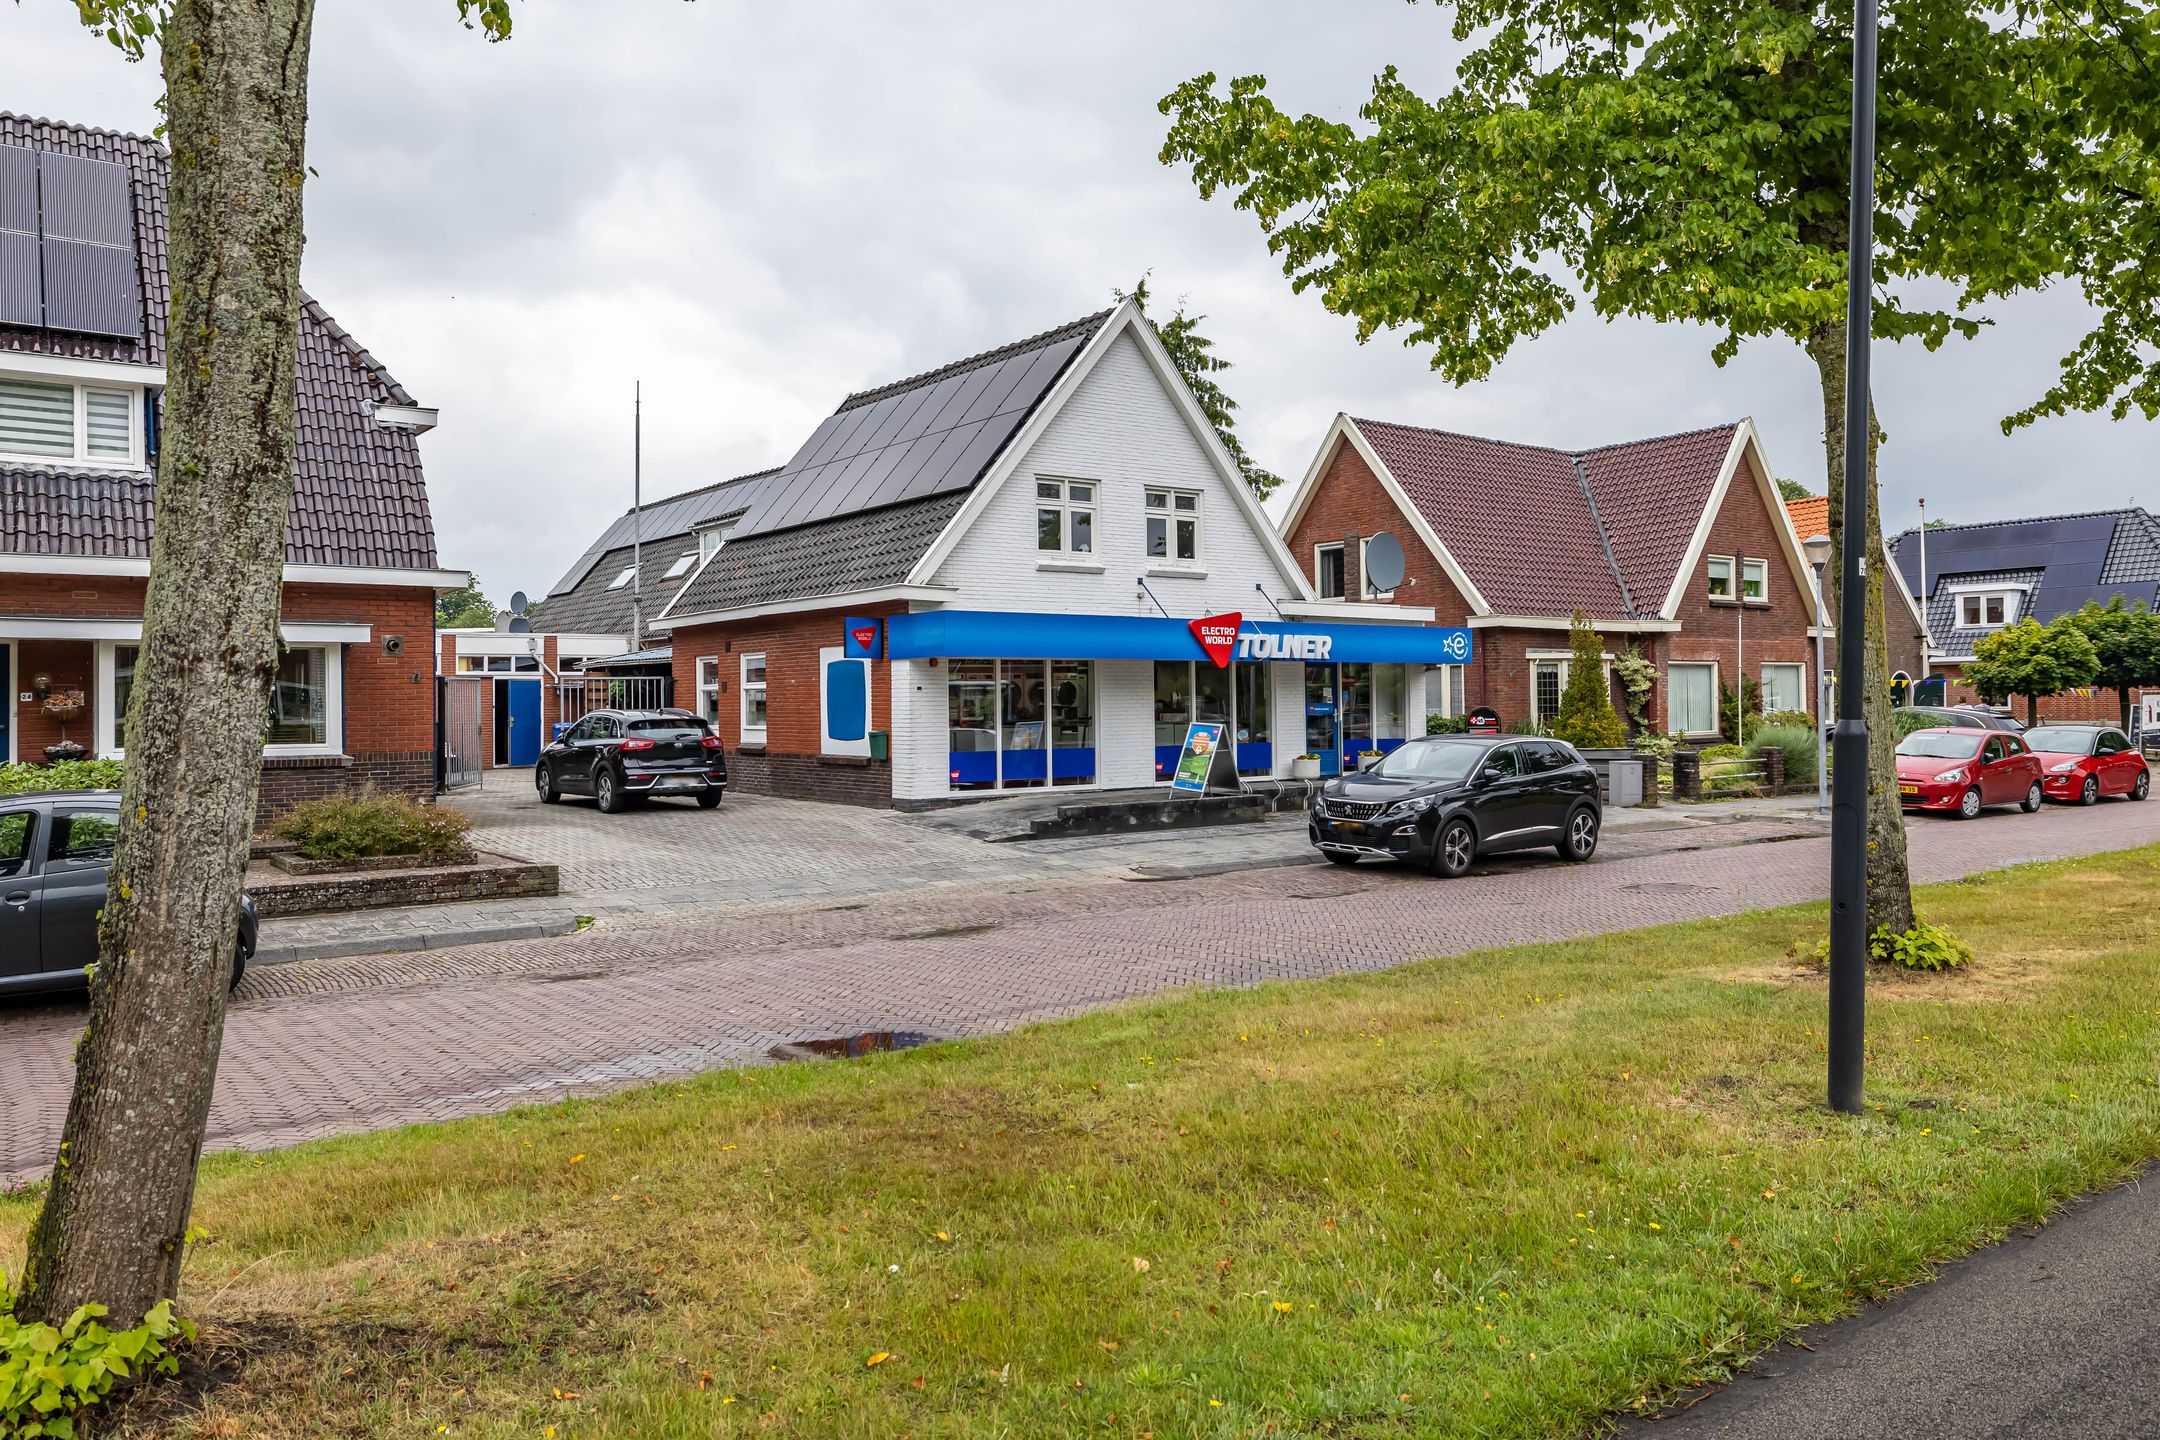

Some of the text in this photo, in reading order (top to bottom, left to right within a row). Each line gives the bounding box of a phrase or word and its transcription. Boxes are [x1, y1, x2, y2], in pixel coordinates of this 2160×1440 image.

[1201, 626, 1235, 636] ELECTRO
[1205, 636, 1232, 645] WORLD
[1237, 634, 1332, 659] TOLNER
